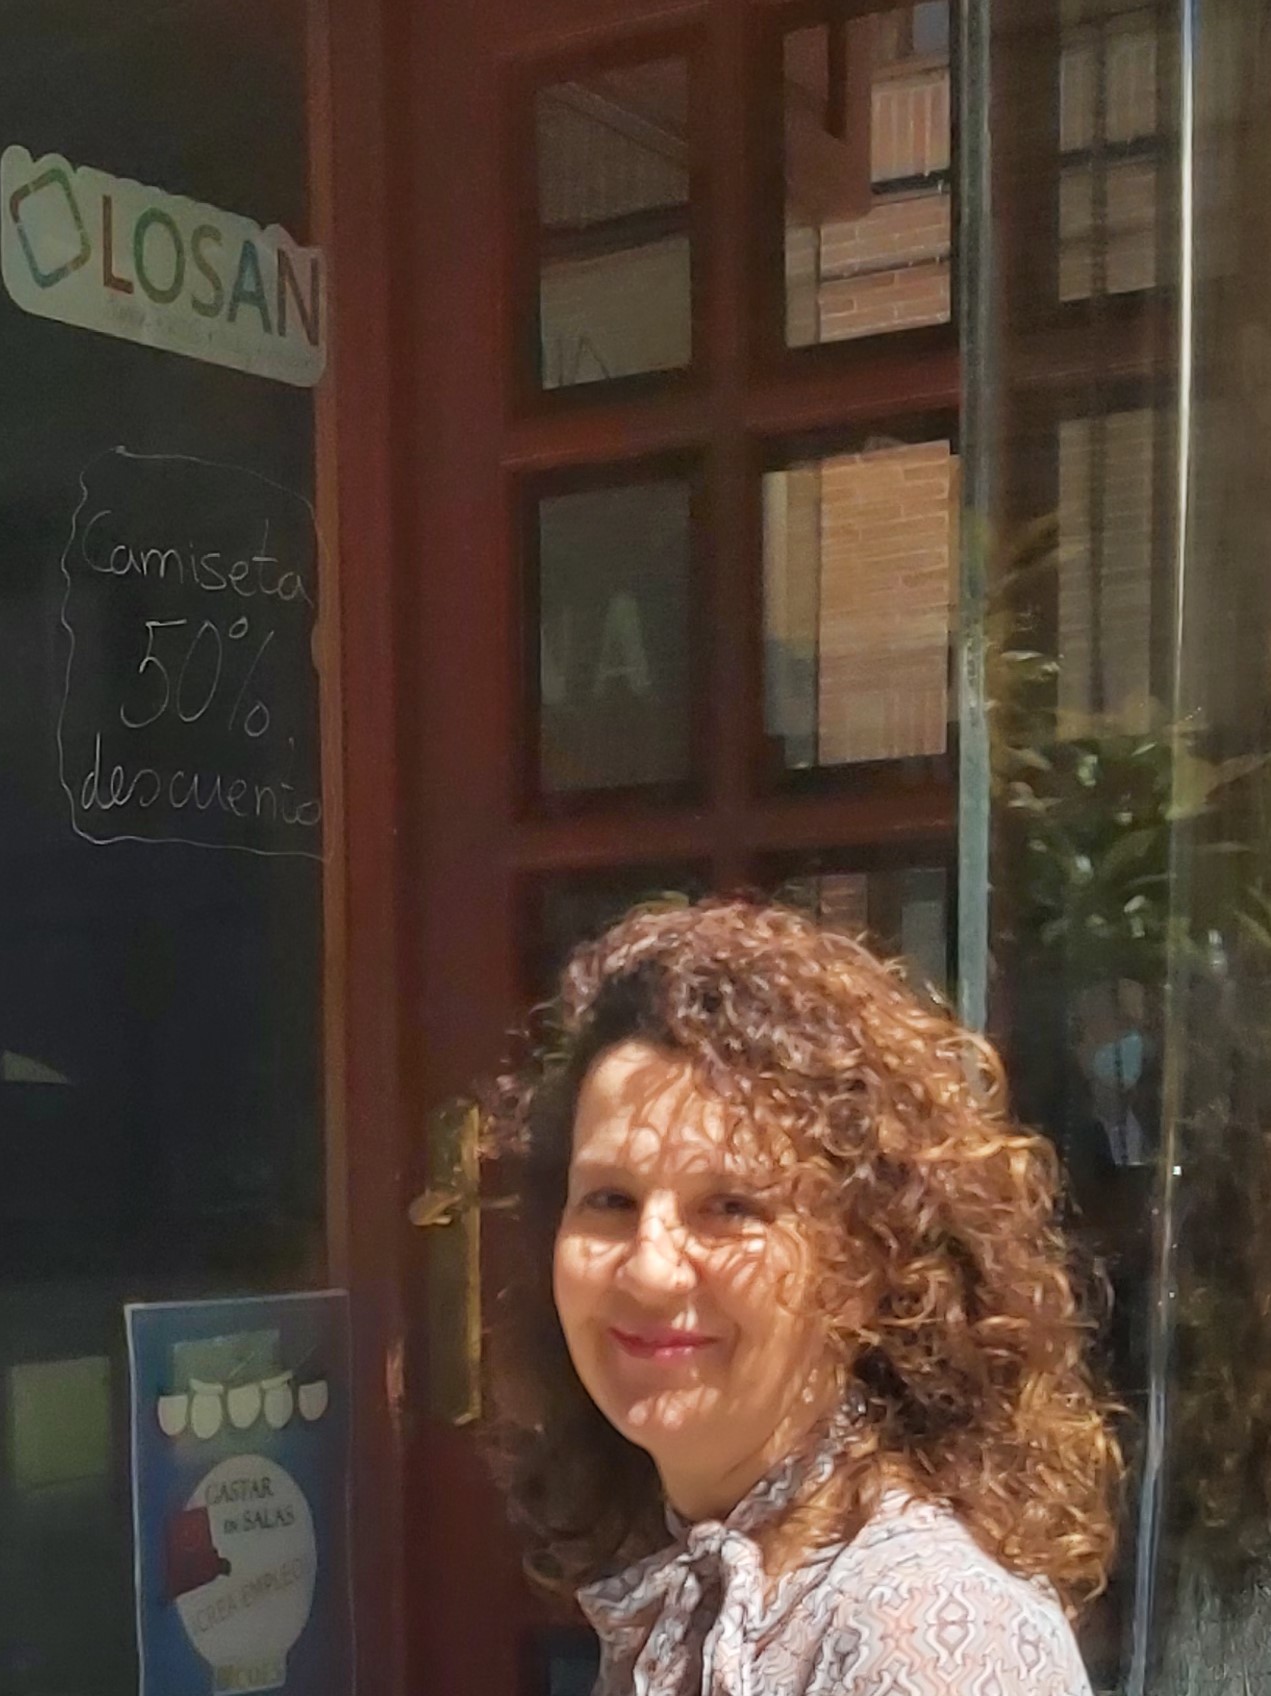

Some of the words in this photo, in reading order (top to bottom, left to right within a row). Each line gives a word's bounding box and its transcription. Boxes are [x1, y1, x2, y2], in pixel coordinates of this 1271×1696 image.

[102, 193, 320, 347] LOSAN
[81, 509, 315, 608] Camiseta
[120, 616, 275, 738] 50%
[81, 732, 322, 826] descuento
[242, 1505, 295, 1532] SALAS
